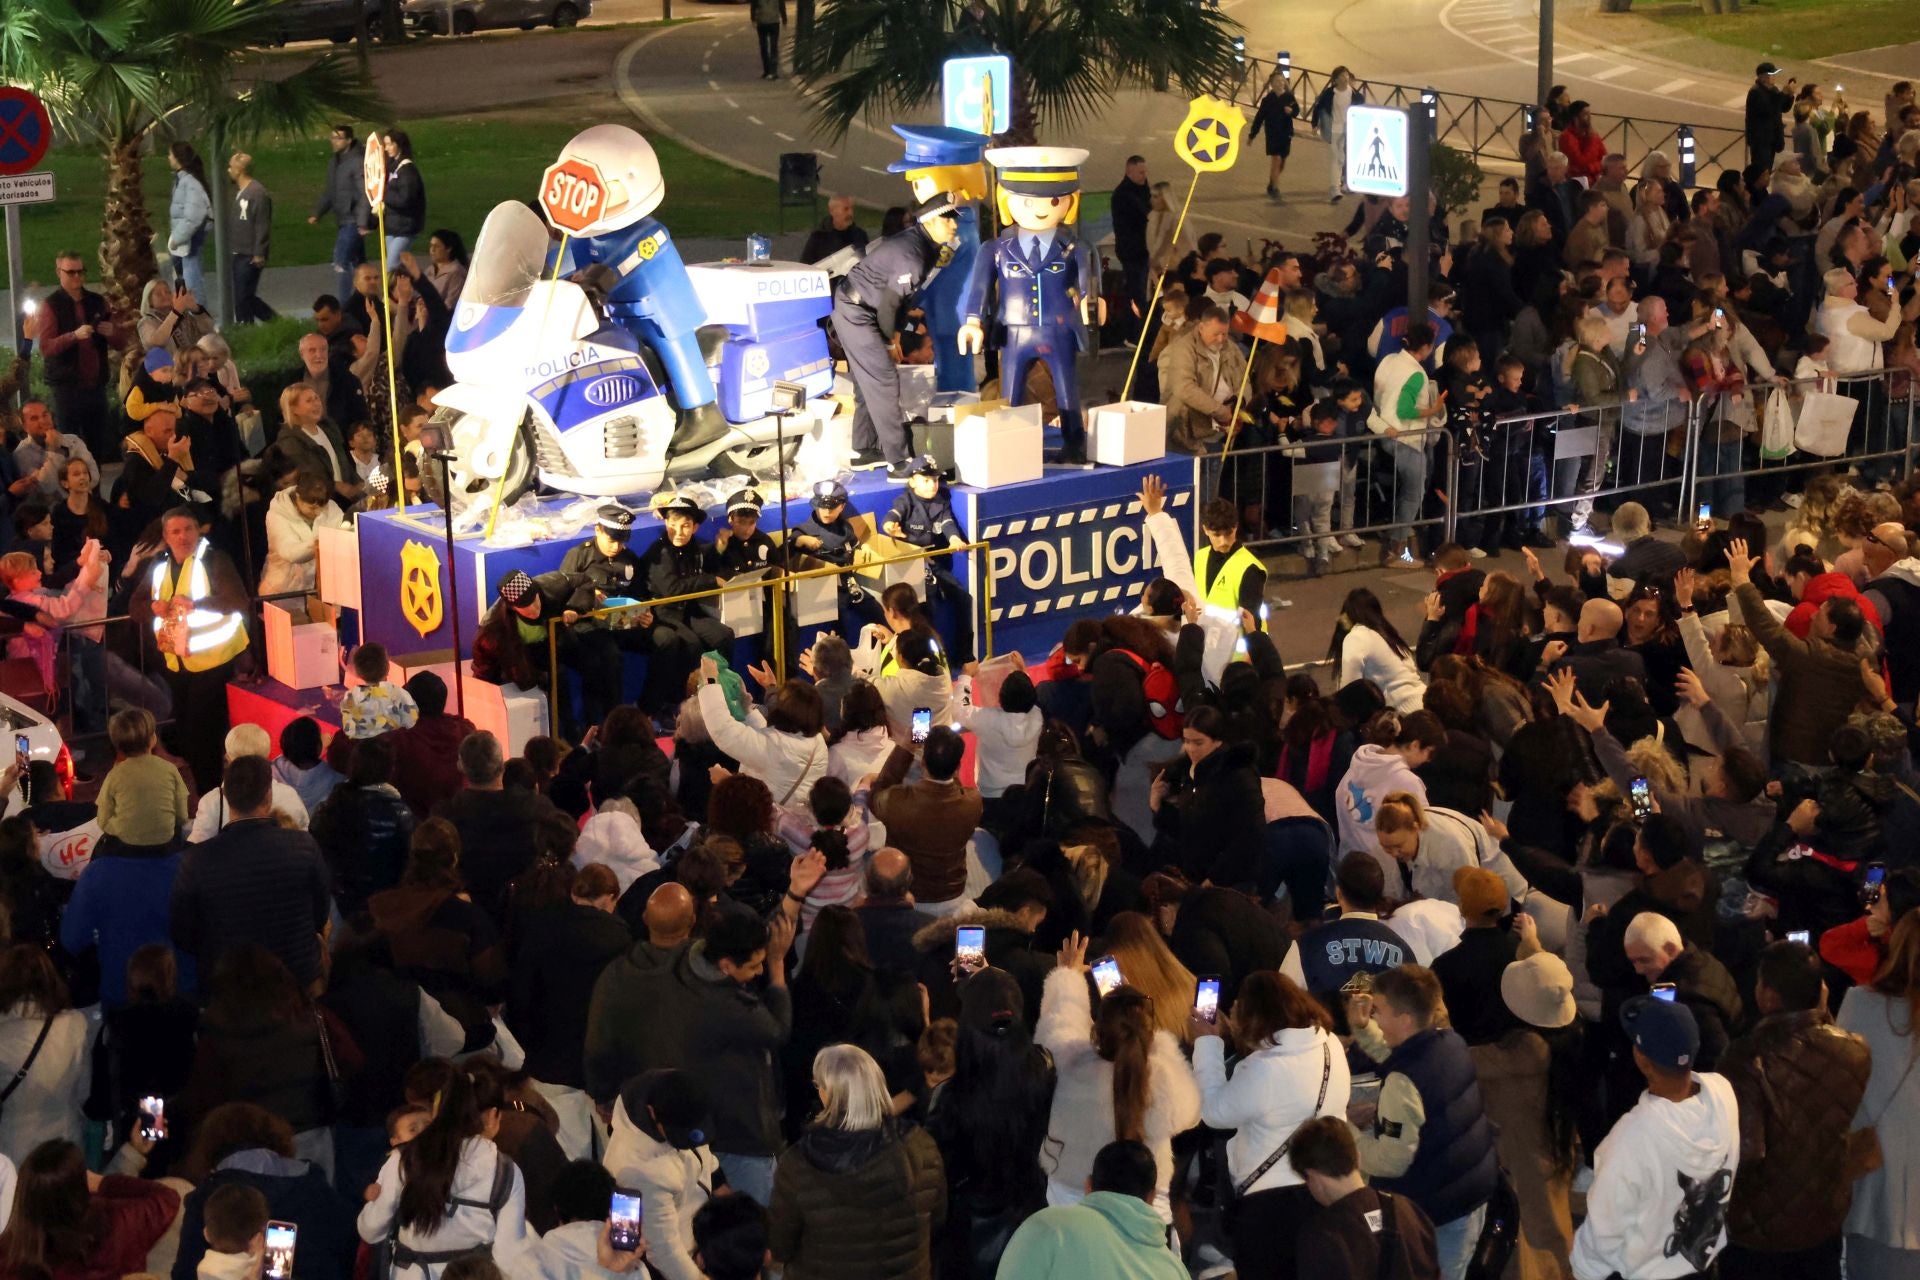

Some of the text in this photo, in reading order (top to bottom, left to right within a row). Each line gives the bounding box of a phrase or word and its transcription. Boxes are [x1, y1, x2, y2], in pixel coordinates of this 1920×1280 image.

[548, 171, 600, 218] STOP
[757, 275, 826, 297] POLICIA
[989, 523, 1163, 599] POLICI
[1325, 938, 1403, 969] STWD
